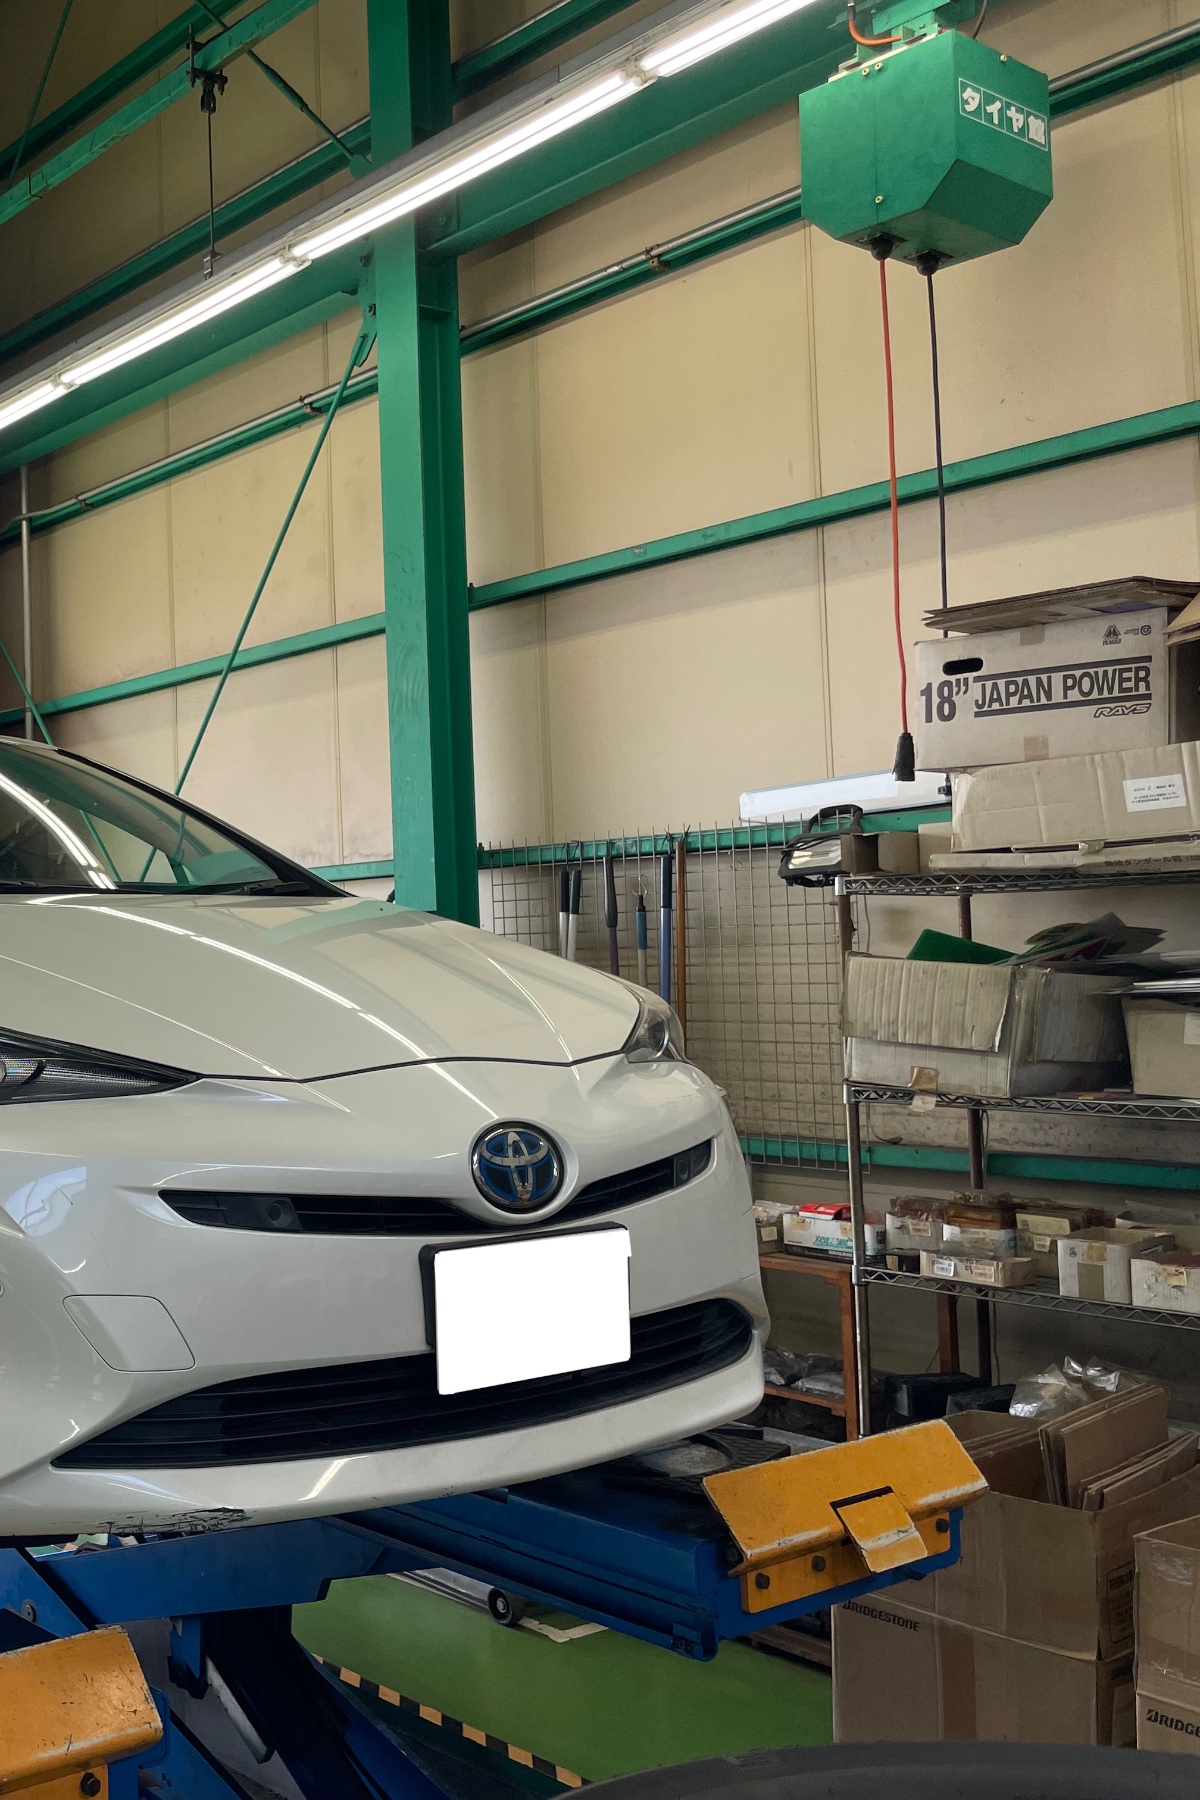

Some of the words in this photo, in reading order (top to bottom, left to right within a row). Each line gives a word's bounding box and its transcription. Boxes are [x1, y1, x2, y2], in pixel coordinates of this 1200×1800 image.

[961, 87, 1046, 145] タイヤ館
[974, 675, 1052, 710] JAPAN
[1062, 665, 1151, 700] POWER
[1093, 702, 1152, 718] RAYS
[842, 1600, 921, 1633] BRIDGESTONE
